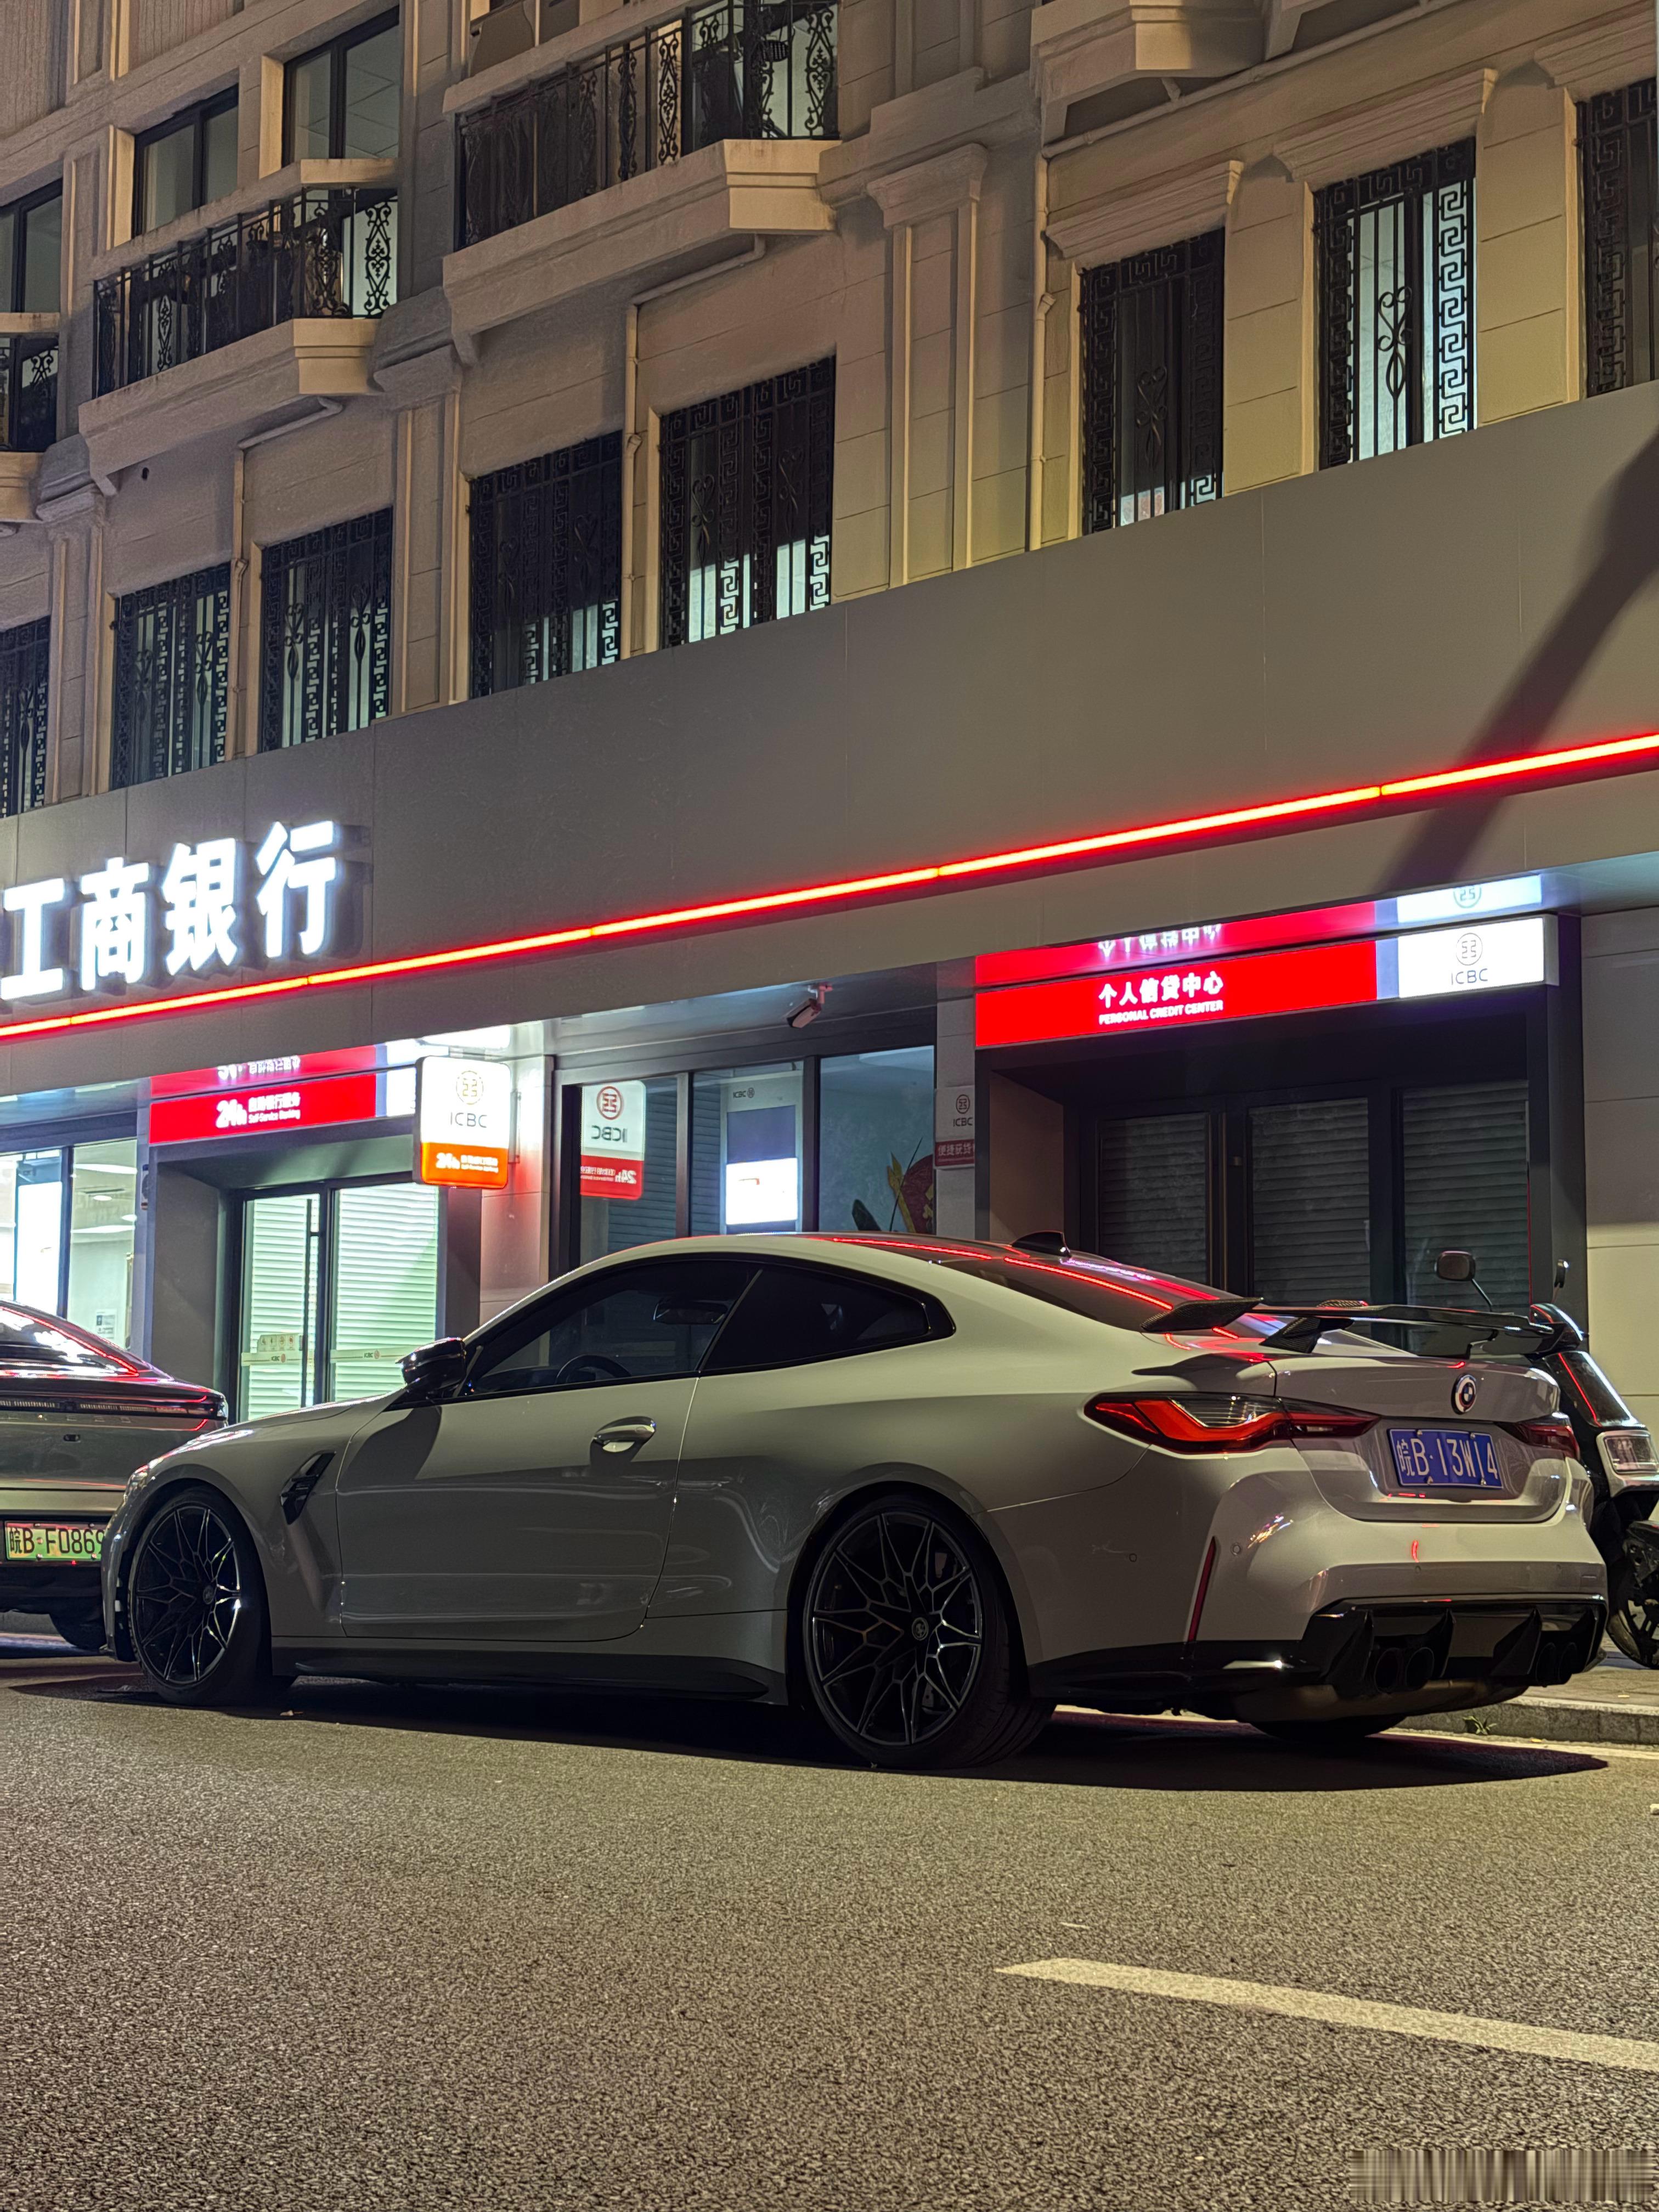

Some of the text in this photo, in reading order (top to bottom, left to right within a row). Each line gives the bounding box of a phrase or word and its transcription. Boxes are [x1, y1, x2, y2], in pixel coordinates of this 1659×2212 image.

[1, 820, 337, 1001] 工商银行
[1451, 968, 1488, 985] ICBC
[1098, 970, 1224, 1008] 个人信贷中心
[1099, 1000, 1224, 1025] PERSONAL CREDIT CENTER
[450, 1111, 488, 1128] ICBC
[953, 1117, 973, 1127] ICBC
[939, 1142, 975, 1156] 便捷获贷
